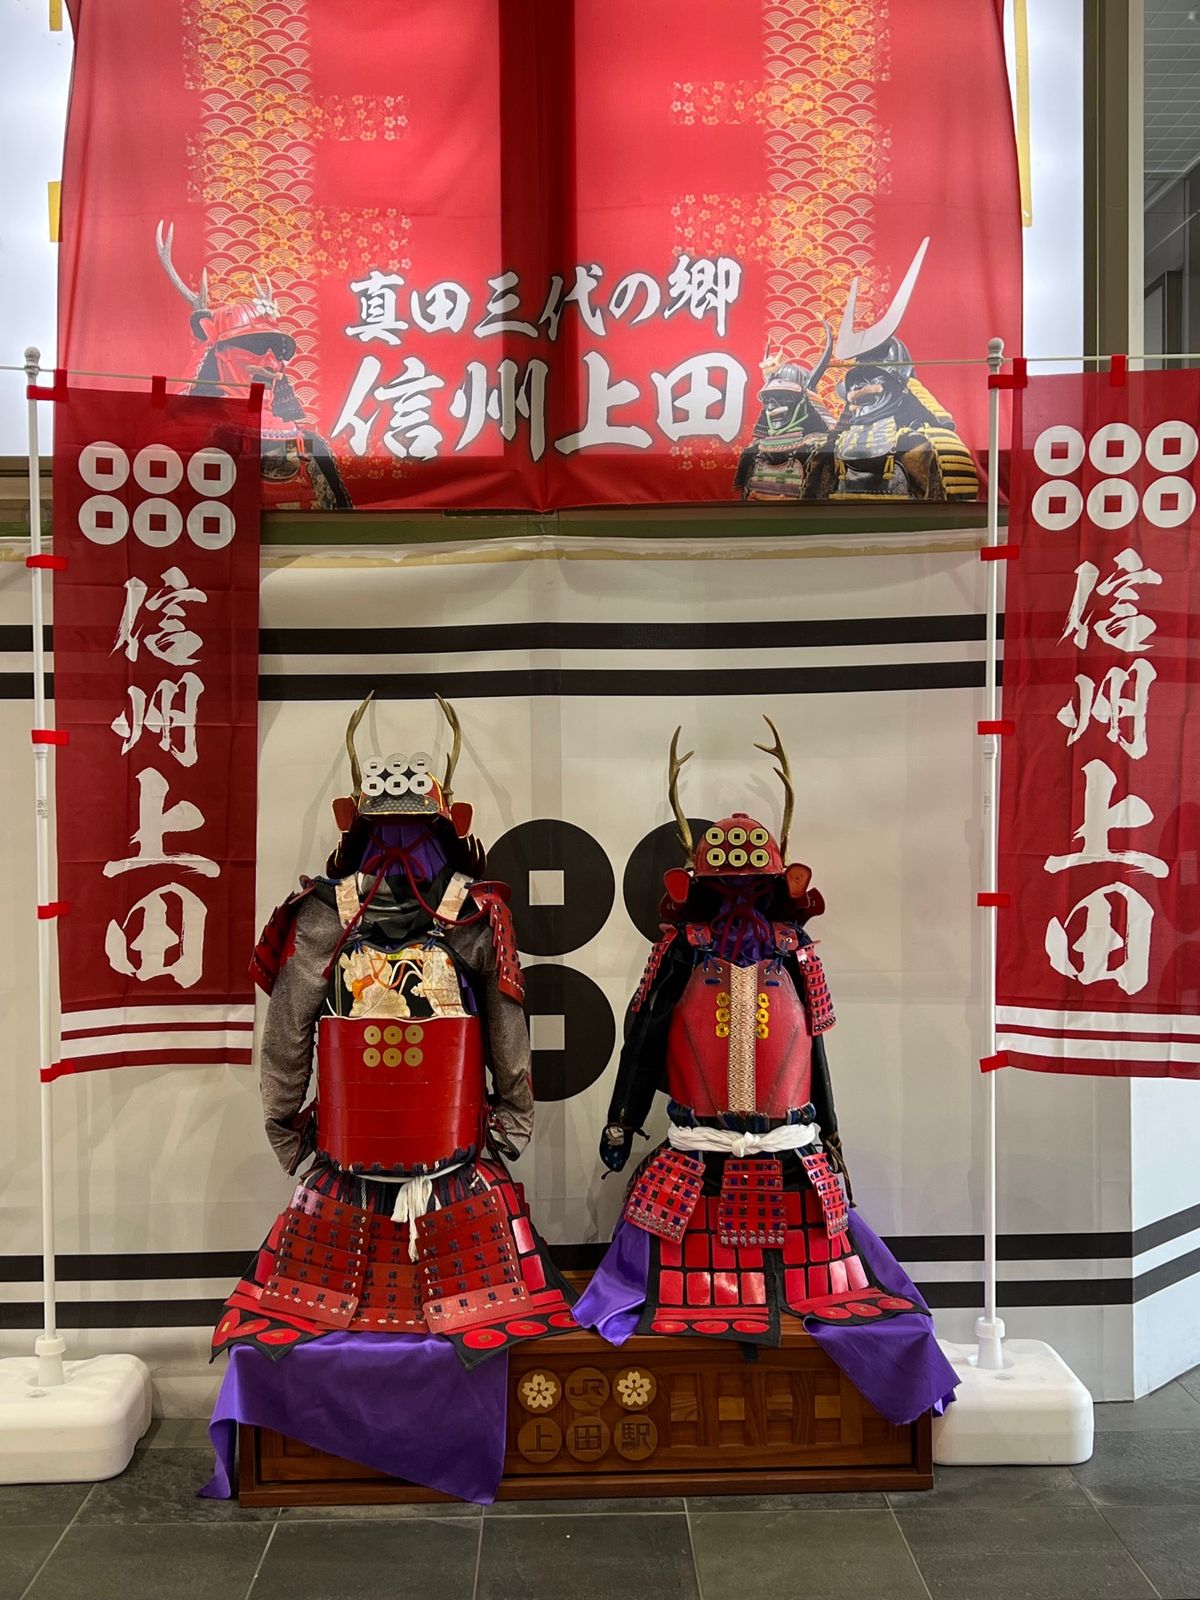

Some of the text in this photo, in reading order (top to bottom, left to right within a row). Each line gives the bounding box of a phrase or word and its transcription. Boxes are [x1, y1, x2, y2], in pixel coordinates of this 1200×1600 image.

[345, 254, 743, 346] 真田三代の郷
[331, 351, 749, 463] 信州上田
[102, 566, 221, 990] 信州上田
[1044, 547, 1170, 997] 信州上田
[524, 1422, 652, 1453] 上田駅
[569, 1378, 604, 1398] JR
